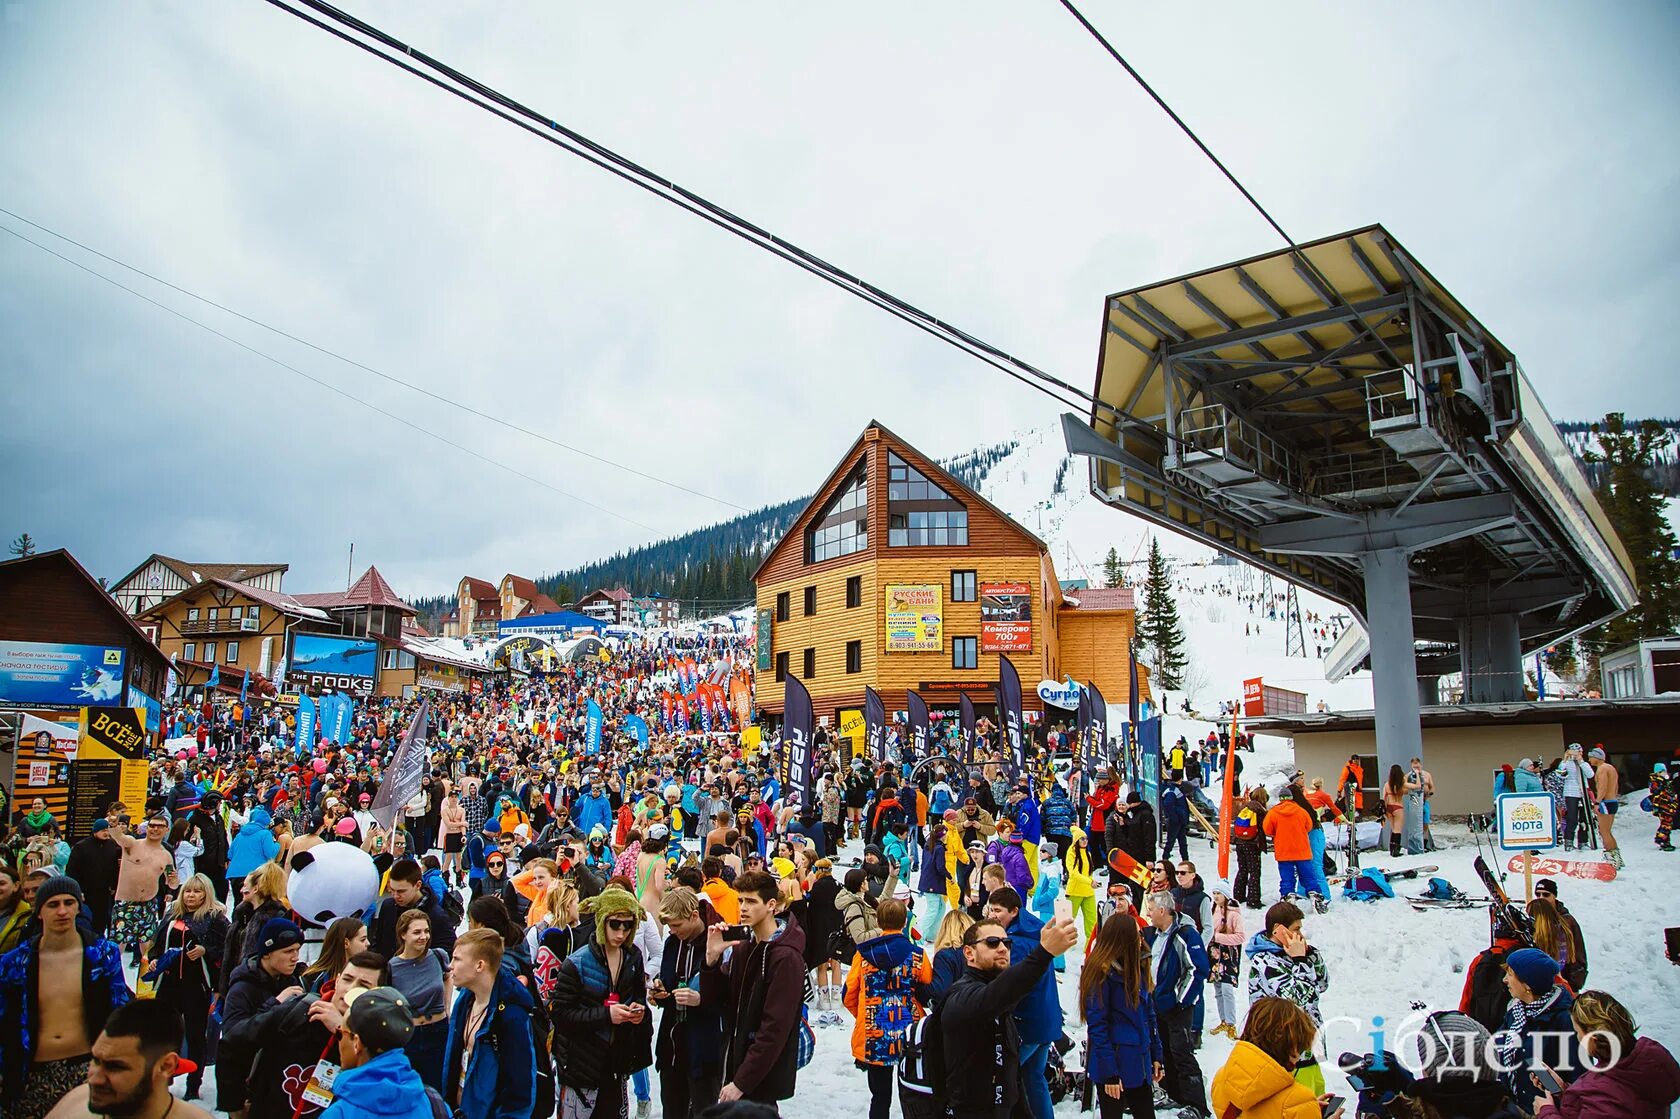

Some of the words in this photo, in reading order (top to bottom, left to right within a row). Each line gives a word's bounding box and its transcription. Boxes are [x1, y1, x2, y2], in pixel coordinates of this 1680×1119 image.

[984, 625, 1029, 633] Кемерово
[1040, 687, 1080, 702] Сугро
[1512, 820, 1543, 831] юрта
[995, 1044, 1003, 1066] EA7
